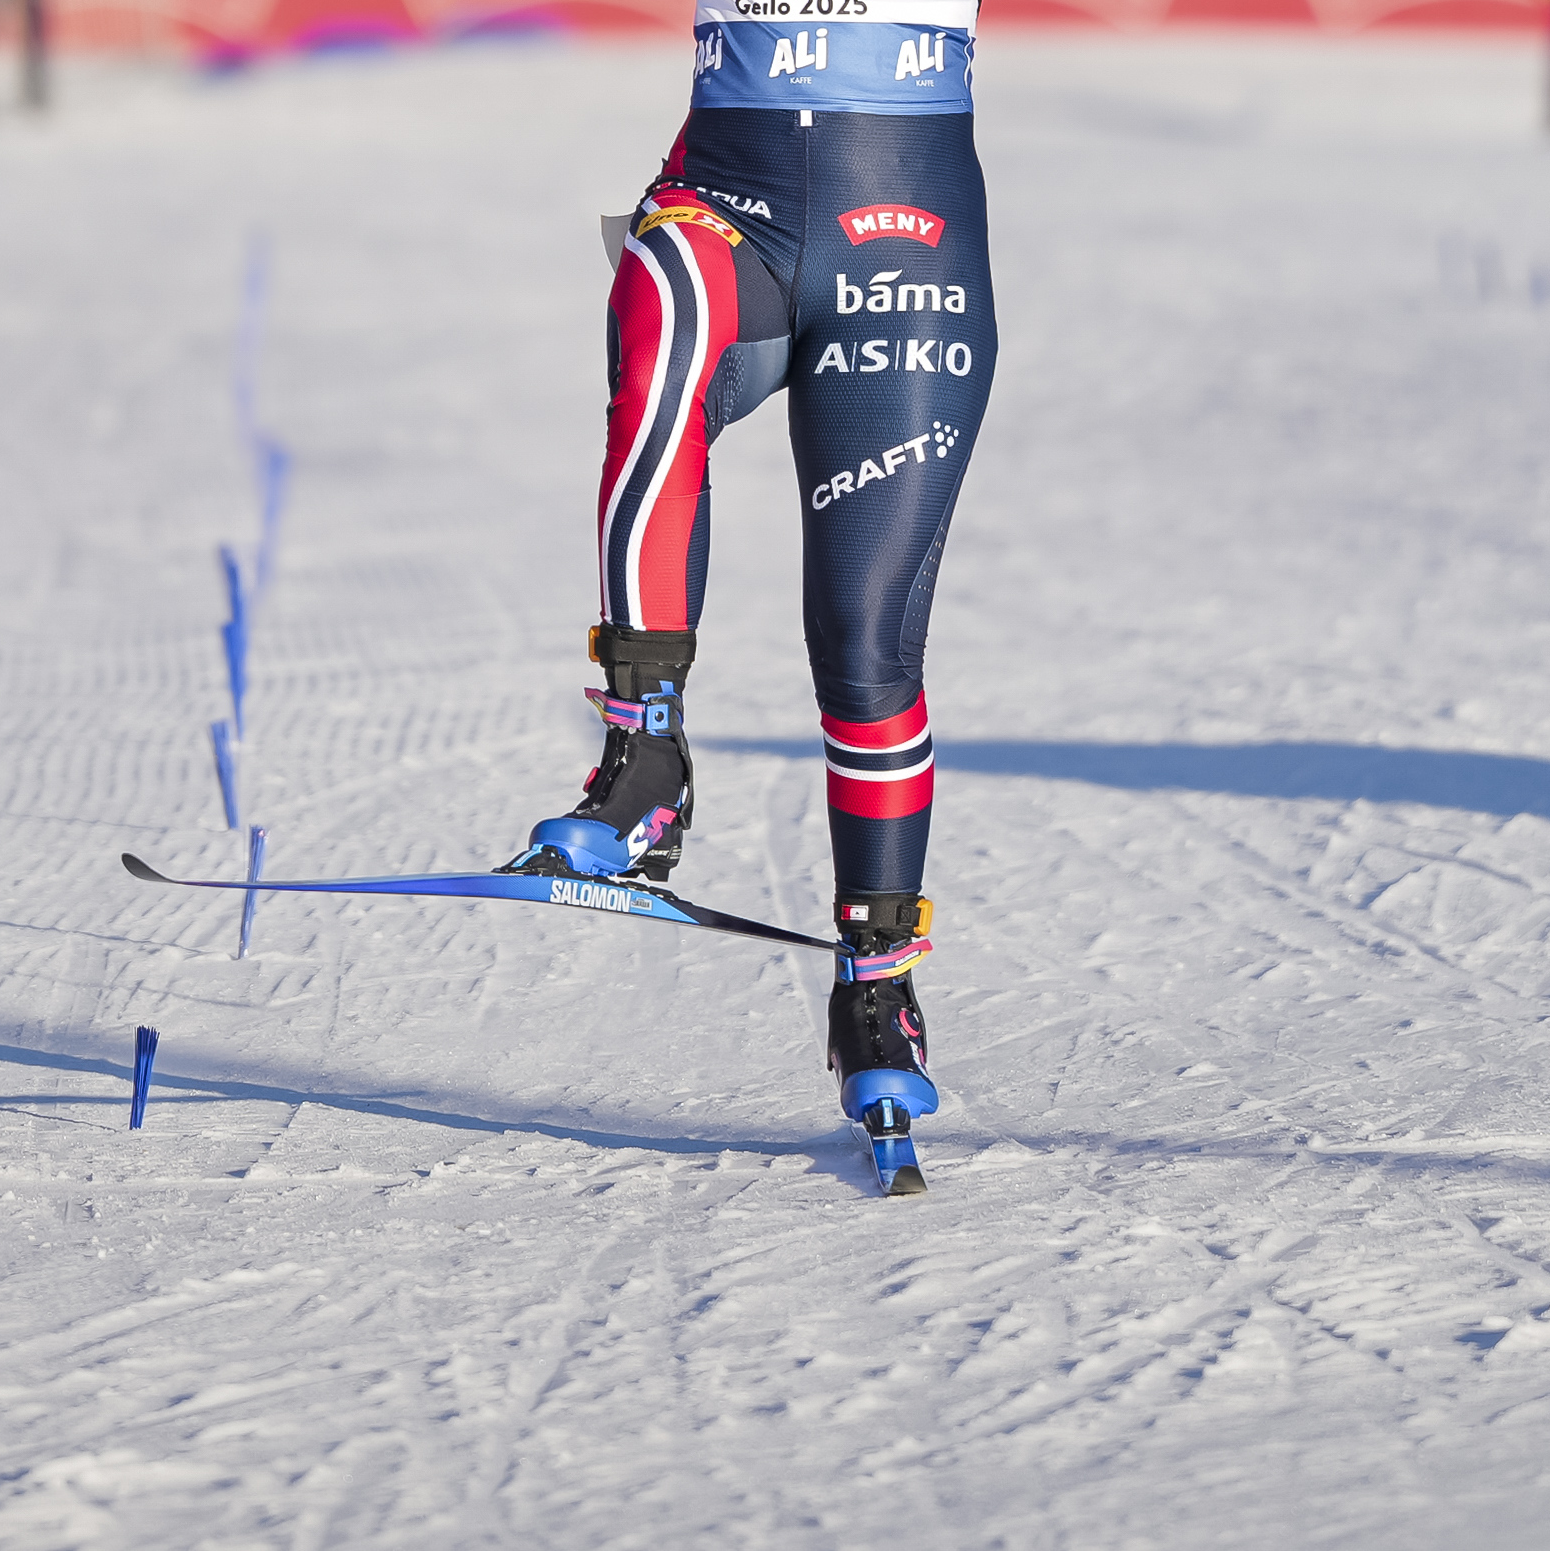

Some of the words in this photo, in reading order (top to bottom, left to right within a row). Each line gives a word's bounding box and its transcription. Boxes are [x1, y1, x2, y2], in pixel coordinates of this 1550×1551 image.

[789, 76, 813, 86] KAFFE
[915, 79, 935, 88] KAFFE
[851, 213, 937, 237] MENY
[811, 433, 931, 511] CRAFT
[549, 879, 632, 913] SALOMON
